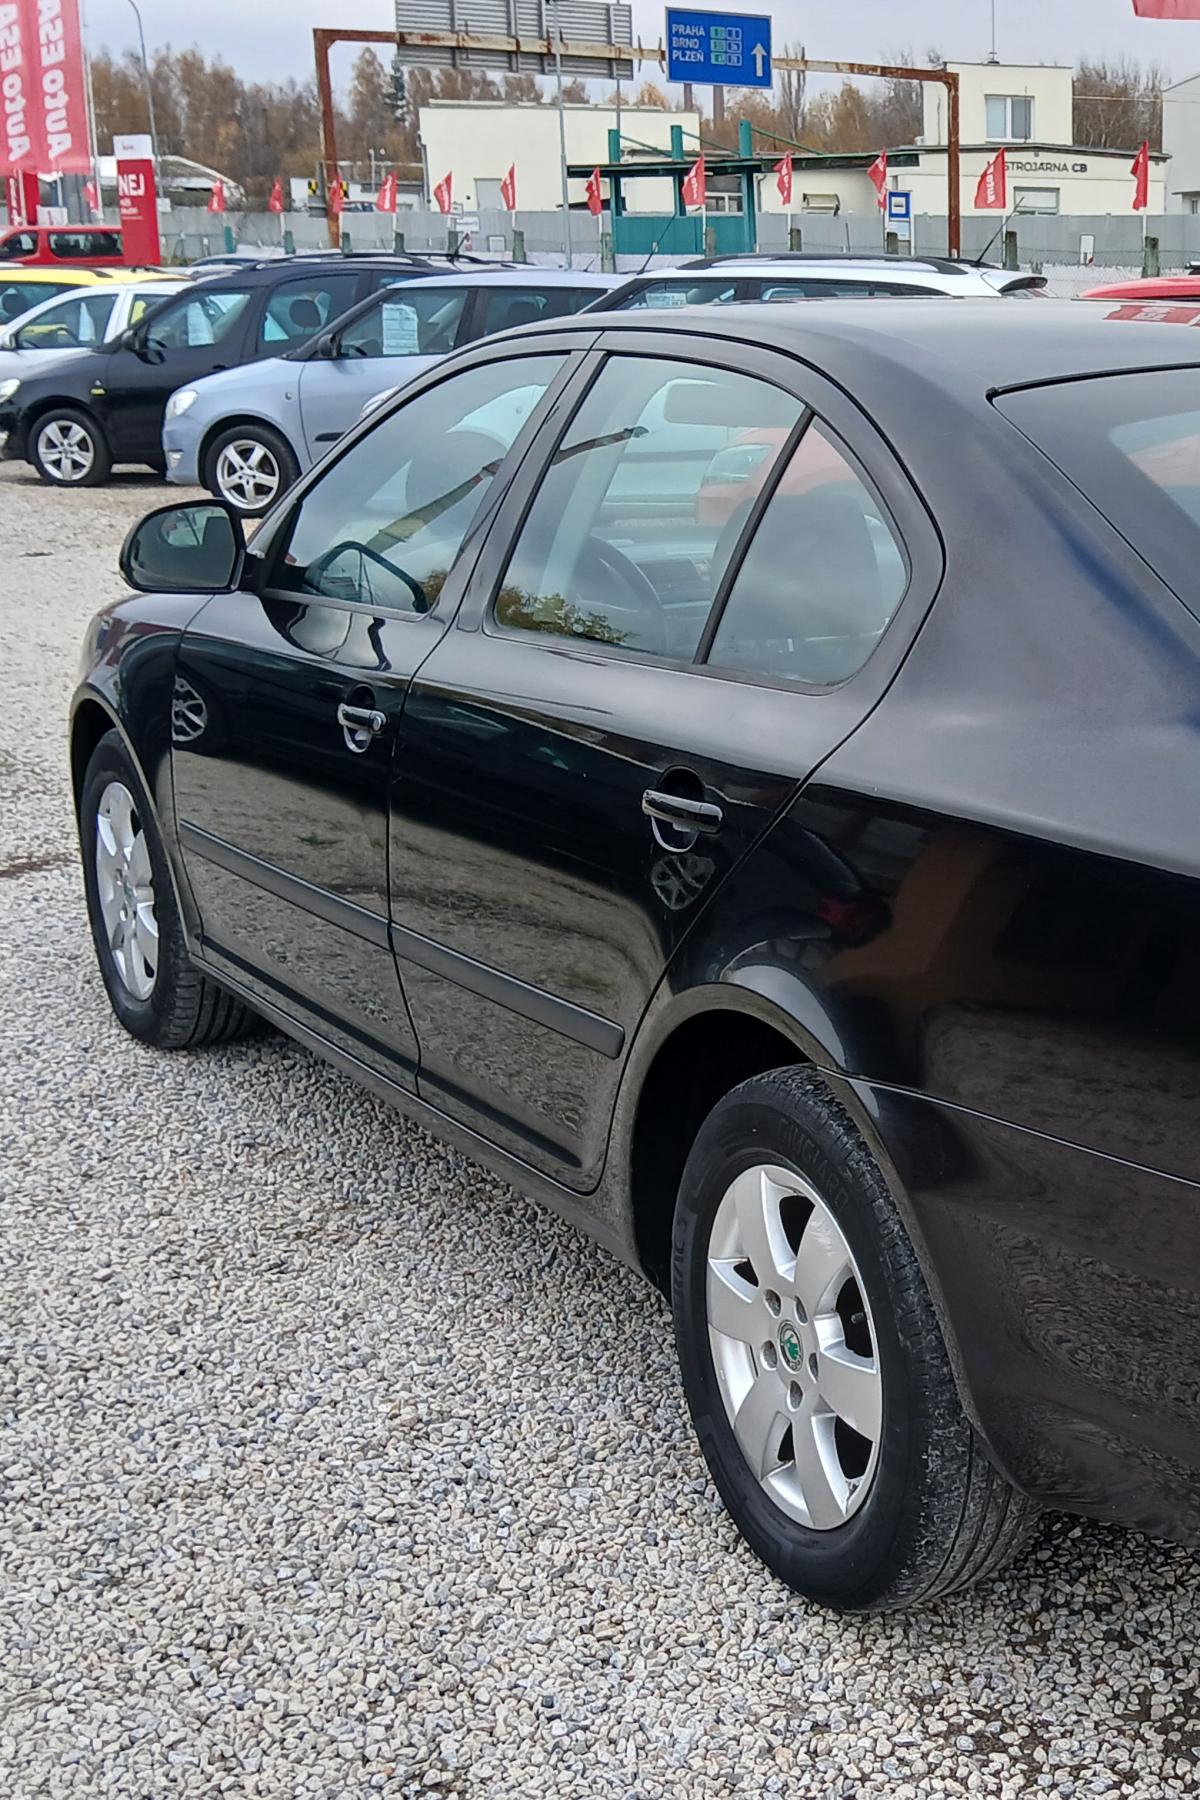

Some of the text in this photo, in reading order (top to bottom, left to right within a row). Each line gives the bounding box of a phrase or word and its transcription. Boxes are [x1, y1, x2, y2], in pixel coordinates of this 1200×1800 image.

[671, 24, 705, 37] PRAHA
[671, 37, 699, 49] BRNO
[1071, 163, 1088, 173] CB
[118, 173, 145, 197] NEJ
